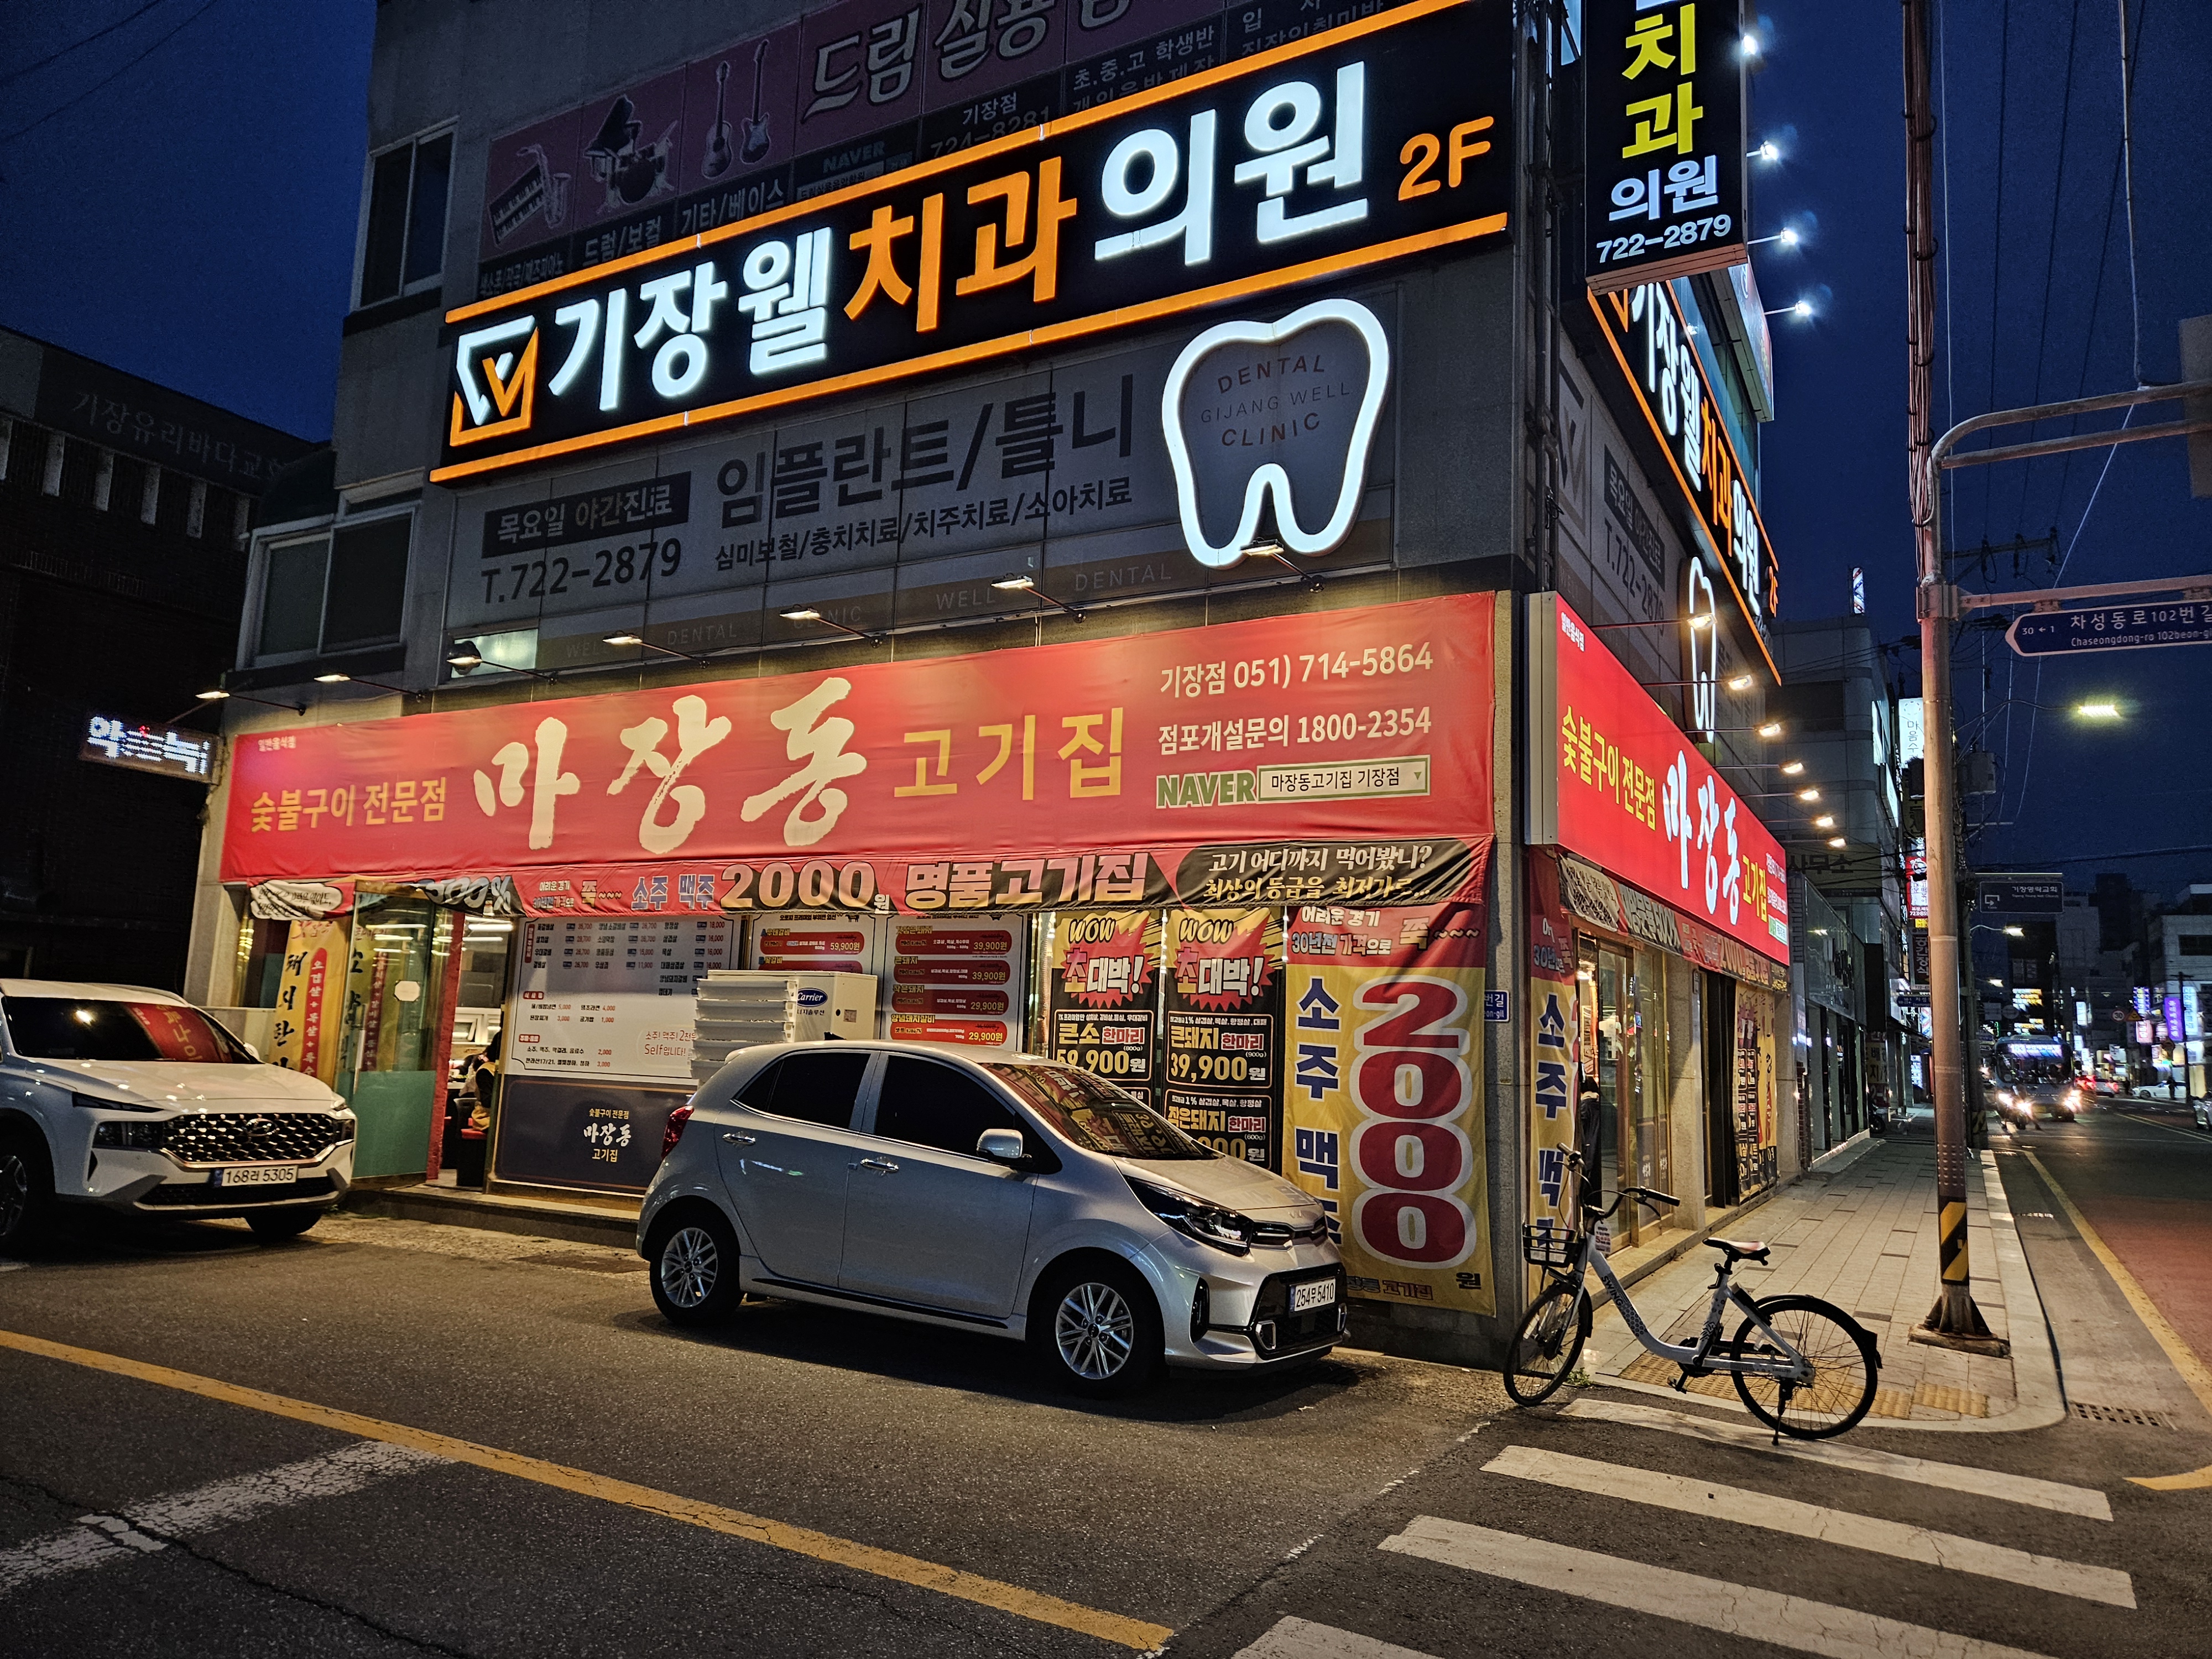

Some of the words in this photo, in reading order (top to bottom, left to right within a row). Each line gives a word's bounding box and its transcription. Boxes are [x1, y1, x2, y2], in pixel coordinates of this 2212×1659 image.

[1156, 25, 1215, 61] 학생반
[962, 91, 1018, 126] 기장점
[823, 141, 885, 174] NAVER
[1399, 116, 1494, 201] 2F
[1609, 155, 1718, 221] 의원
[681, 179, 784, 236] 기타/베이스
[582, 216, 662, 267] 드럼/보컬
[1597, 214, 1731, 264] 722-2879
[1218, 354, 1326, 394] DENTAL
[1201, 396, 1279, 423] GIJANG
[1291, 382, 1350, 406] WELL
[72, 392, 276, 478] 기장유리바다교
[1221, 412, 1320, 447] CLINIC
[718, 374, 1133, 529] 임플란트/틀니
[498, 503, 566, 544] 목요일
[575, 484, 673, 530] 야간진료
[481, 538, 681, 604] T.722-2879
[667, 623, 737, 645] DENTAL
[1074, 561, 1171, 592] DENTAL
[2022, 627, 2034, 635] 30
[2072, 633, 2154, 647] Chaseongdong-ro
[1160, 661, 1226, 698] 기장점
[1233, 654, 1291, 688] 051)
[1299, 641, 1433, 682] 714-5864
[258, 736, 296, 752] 일반음식점
[1158, 715, 1289, 755] 점포개설문의
[1297, 706, 1431, 743] 1800-2354
[1907, 721, 1919, 760] 마음수
[252, 785, 354, 833] 숯불구이
[363, 777, 446, 825] 전문점
[473, 677, 867, 854] 마장동
[894, 707, 1123, 801] 고기집
[1156, 770, 1257, 809] NAVER
[1271, 771, 1352, 793] 마장동고기집
[1358, 767, 1400, 788] 기장점
[1562, 706, 1619, 804] 숯불구이
[1623, 755, 1656, 831] 전문점
[1662, 750, 1740, 926] 마장동
[1743, 854, 1767, 923] 고기집
[1208, 849, 1247, 874] 고기
[1251, 848, 1328, 873] 어디까지
[1337, 845, 1433, 872] 먹어봤니?
[539, 880, 557, 891] 어려운
[558, 879, 570, 891] 경기
[631, 875, 669, 910] 소주
[678, 874, 716, 910] 맥주
[1203, 878, 1261, 901] 최상의
[1266, 875, 1325, 899] 등급을
[1068, 917, 1117, 944] WOW
[1179, 917, 1234, 945] WOW
[1301, 906, 1345, 926] 어려운
[1348, 910, 1380, 928] 경기
[831, 942, 860, 952] 59,900원
[973, 942, 1007, 951] 39,900원
[1292, 933, 1337, 956] 30년전
[1339, 935, 1392, 956] 가격으로
[894, 956, 919, 965] 큰돼지
[1064, 947, 1145, 994] 초대박!
[1177, 946, 1265, 998] 초대박!
[972, 972, 1006, 981] 39,900원
[797, 992, 823, 1002] Carrier
[971, 1001, 1004, 1011] 29,900원
[891, 1014, 935, 1023] 양념돼지갈비
[645, 1032, 661, 1041] 소주!
[662, 1031, 679, 1041] 맥주!
[968, 1032, 1003, 1042] 29,900원
[1102, 1026, 1145, 1045] 한마리
[1171, 1026, 1219, 1050] 큰돼지
[1221, 1032, 1264, 1051] 한마리
[1295, 975, 1342, 1102] 소주
[1535, 992, 1568, 1120] 소주
[589, 1108, 612, 1119] 숯불구이
[612, 1109, 629, 1120] 전문점
[1167, 1106, 1226, 1132] 작은돼지
[1228, 1116, 1266, 1133] 한마리
[1349, 974, 1477, 1270] 2000
[583, 1122, 632, 1147] 마장동
[592, 1148, 618, 1163] 고기집
[226, 1168, 260, 1185] 168러
[263, 1168, 294, 1183] 5305
[1296, 1287, 1317, 1308] 254무
[1317, 1281, 1335, 1304] 5410
[1347, 1275, 1381, 1293] 장동
[1383, 1279, 1433, 1301] 고기집
[1455, 1272, 1482, 1290] 원
[1601, 1275, 1624, 1306] SWING
